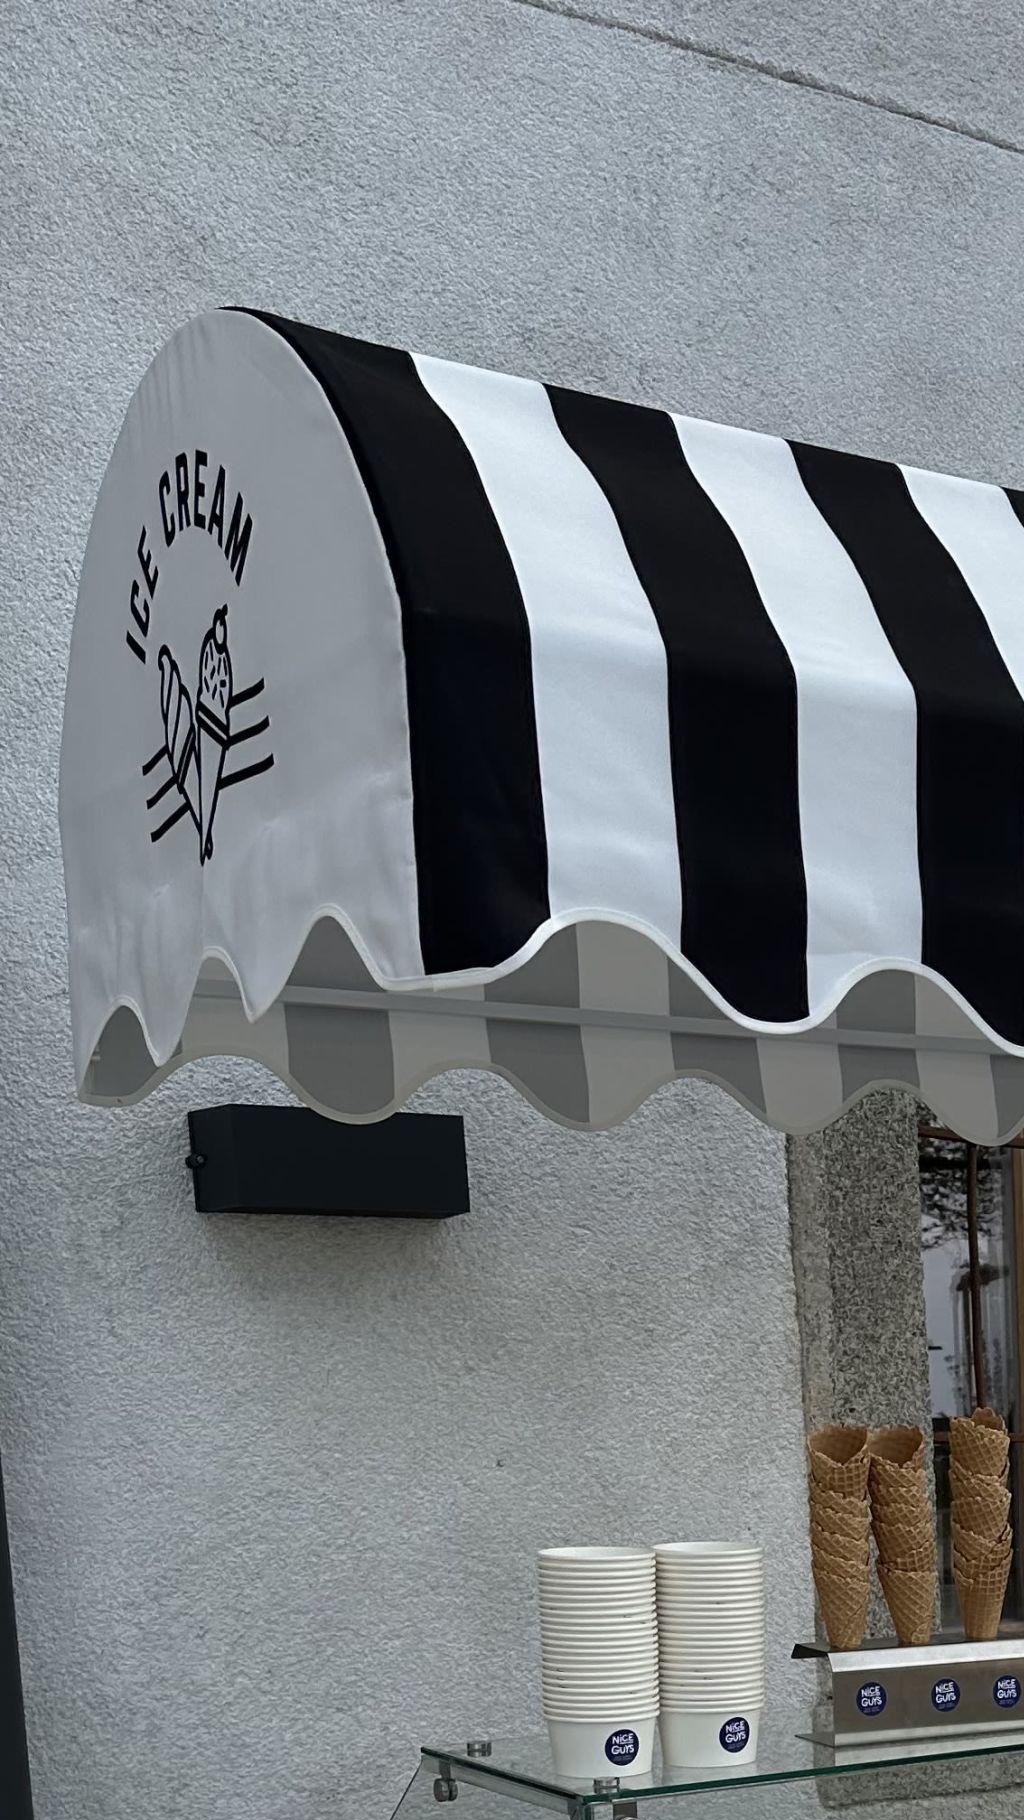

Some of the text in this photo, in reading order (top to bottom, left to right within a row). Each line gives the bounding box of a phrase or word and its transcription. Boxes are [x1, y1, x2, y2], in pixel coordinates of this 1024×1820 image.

[126, 448, 253, 664] ICE CREAM
[935, 1692, 957, 1704] GUYS
[997, 1689, 1017, 1699] GUYS
[861, 1696, 883, 1708] GUYS
[724, 1731, 747, 1744] GUYS
[611, 1744, 635, 1755] GUYS
